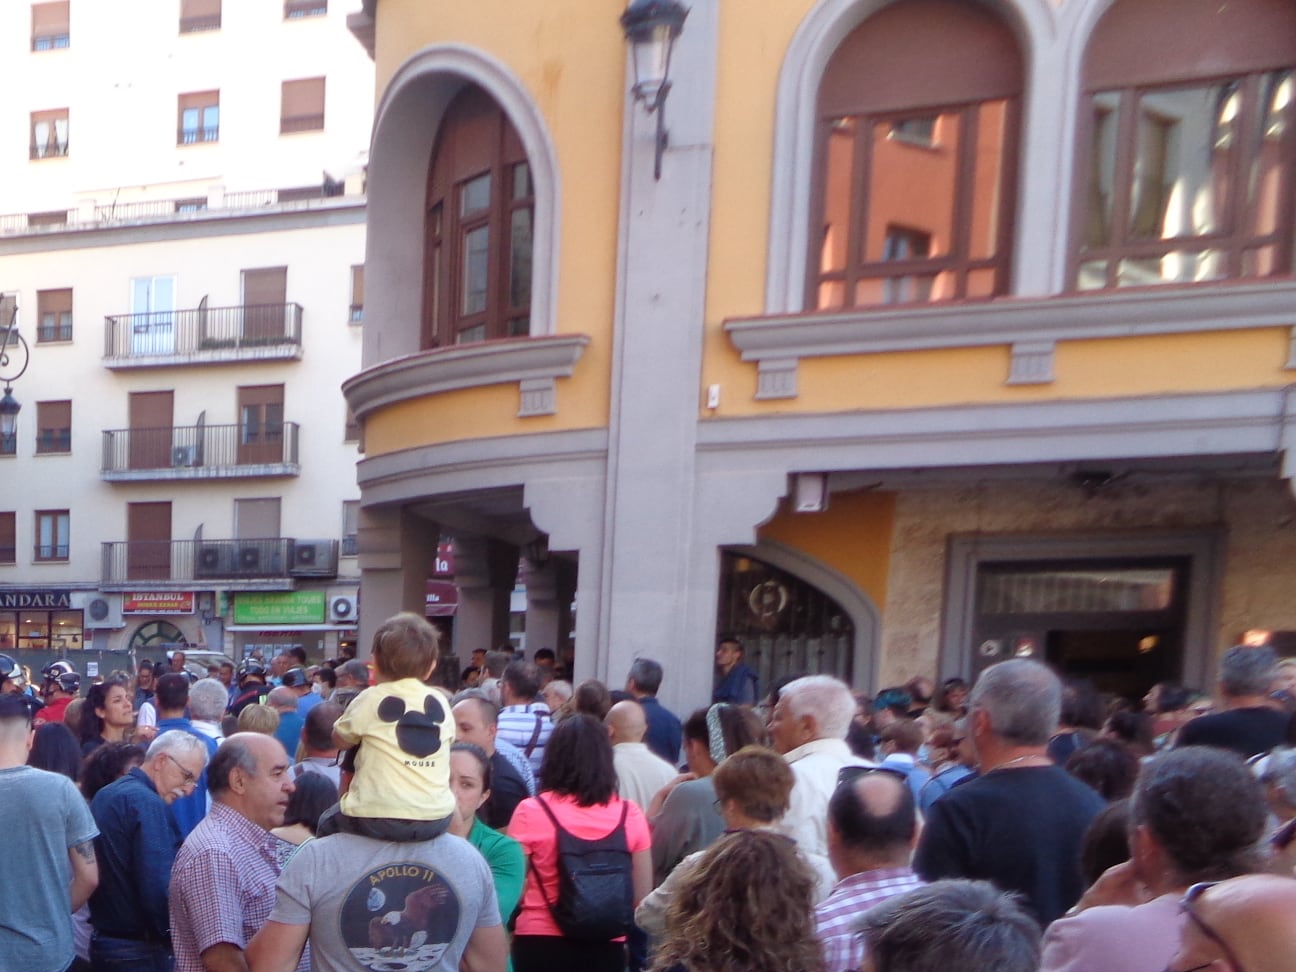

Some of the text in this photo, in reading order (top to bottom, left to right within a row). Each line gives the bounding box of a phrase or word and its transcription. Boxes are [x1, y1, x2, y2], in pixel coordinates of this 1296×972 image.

[132, 592, 184, 601] ISTANBUL
[404, 760, 435, 768] MOUSE
[369, 865, 434, 886] APOLLO 11
